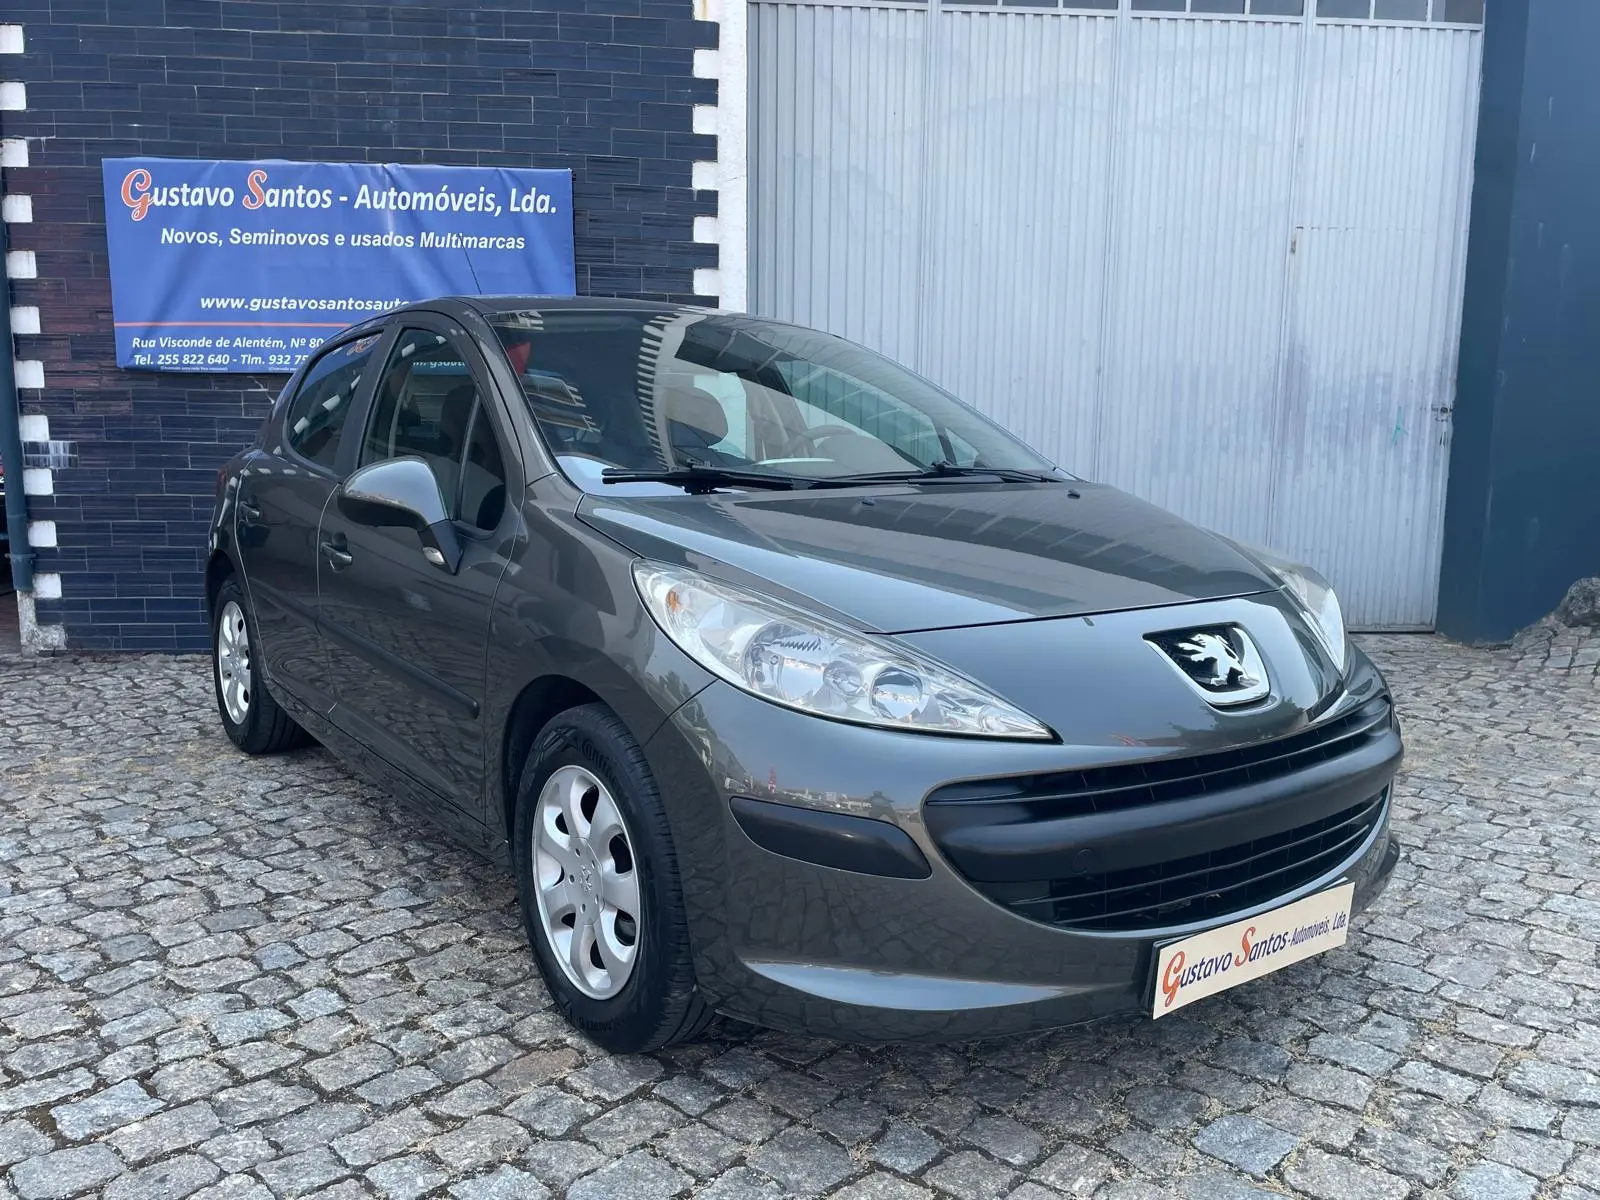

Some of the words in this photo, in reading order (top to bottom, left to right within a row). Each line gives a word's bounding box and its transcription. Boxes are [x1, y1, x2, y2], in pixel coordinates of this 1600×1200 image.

[121, 168, 235, 222] Gustavo
[242, 169, 333, 210] Santos
[353, 184, 502, 217] Automóveis,
[509, 187, 557, 214] Lda.
[160, 227, 223, 248] Novos,
[229, 228, 330, 246] Seminovos
[334, 233, 346, 246] e
[350, 232, 415, 248] usados
[419, 231, 526, 250] Multimarcas
[132, 337, 157, 349] Rua
[159, 336, 212, 349] Visconde
[215, 337, 230, 349] de
[233, 337, 287, 350] Alentém,
[134, 354, 153, 366] Tel.
[157, 354, 180, 366] 255
[182, 354, 205, 366] 822
[207, 354, 230, 366] 640
[240, 354, 265, 366] Tlm.
[268, 354, 291, 366] 932
[1162, 951, 1232, 1007] Gustavo
[1332, 911, 1347, 931] Lda.
